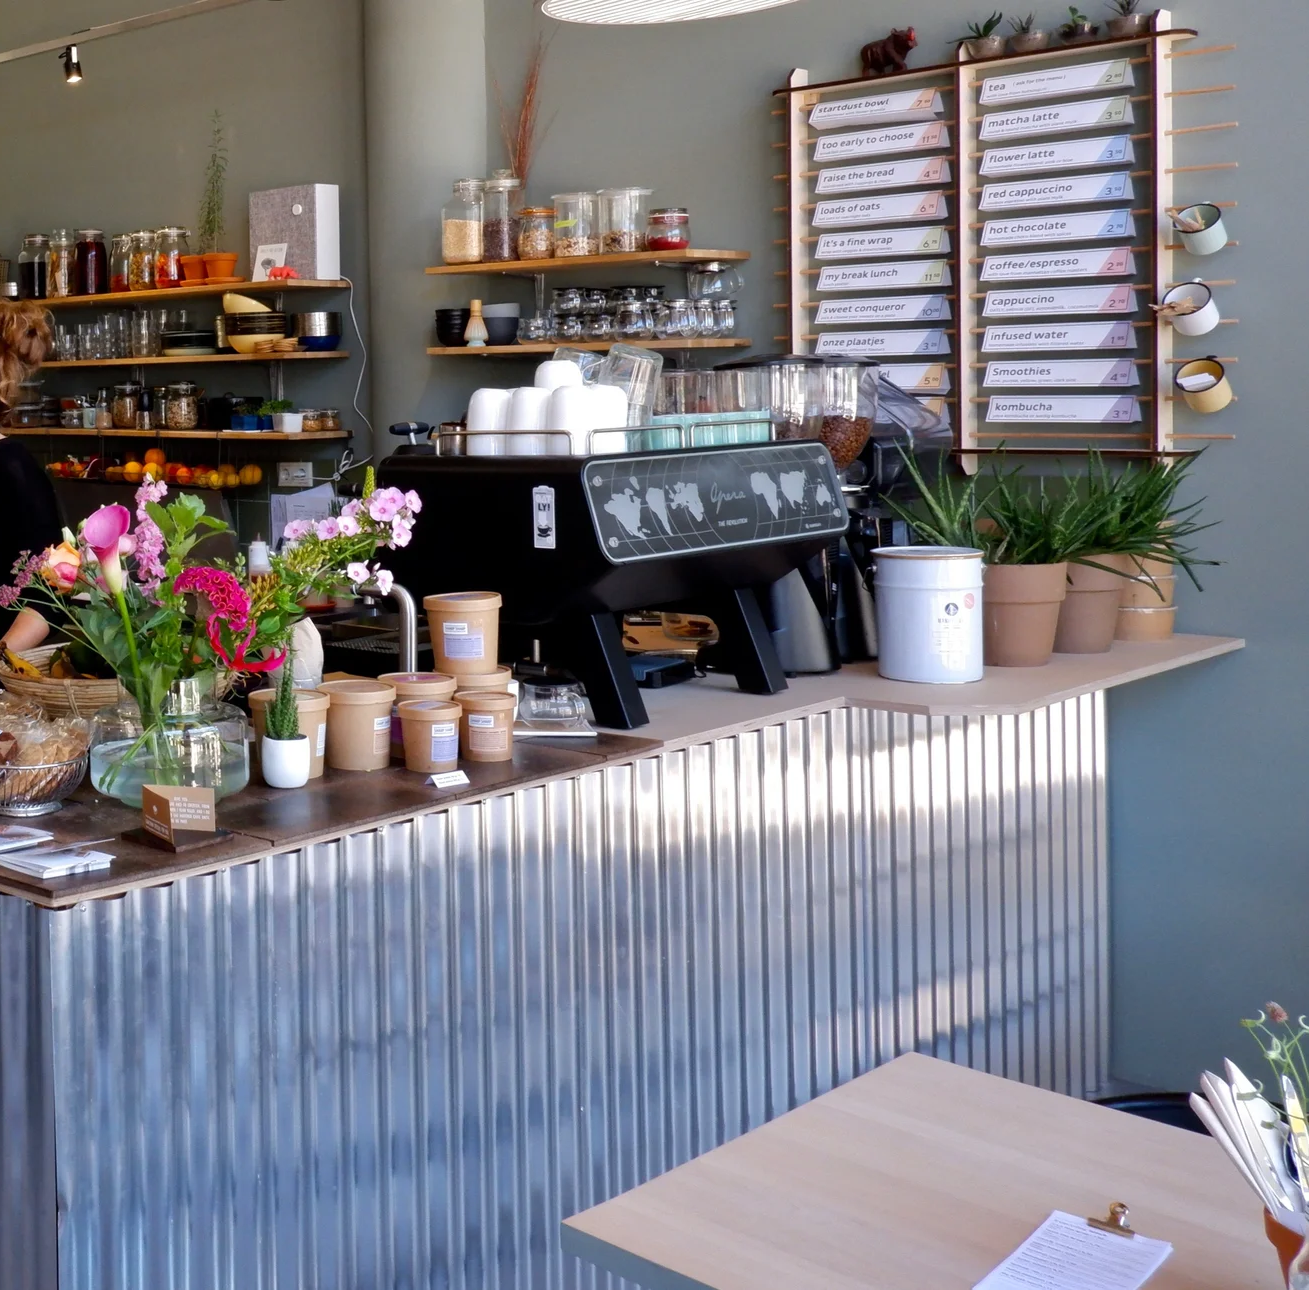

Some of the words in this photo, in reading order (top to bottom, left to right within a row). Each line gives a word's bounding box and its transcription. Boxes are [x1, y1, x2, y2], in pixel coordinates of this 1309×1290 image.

[988, 83, 1006, 91] tea
[818, 102, 862, 113] startdust
[865, 98, 890, 108] bowl
[988, 116, 1029, 128] matcha
[1032, 111, 1060, 122] latte
[822, 139, 838, 149] too
[840, 137, 864, 148] early
[866, 135, 876, 144] to
[879, 132, 914, 142] choose
[989, 152, 1026, 163] flower
[1028, 149, 1055, 159] latte
[823, 172, 846, 182] raise
[848, 171, 864, 180] the
[866, 168, 894, 178] bread
[988, 189, 1006, 198] red
[1009, 184, 1072, 197] cappuccino
[820, 205, 845, 215] loads
[848, 204, 858, 213] of
[859, 203, 880, 211] oats
[989, 225, 1008, 235] hot
[1011, 222, 1067, 233] chocolate
[823, 239, 838, 248] it's
[847, 237, 865, 246] fine
[867, 236, 893, 245] wrap
[989, 257, 1079, 270] coffee/espresso
[824, 273, 840, 282] my
[841, 270, 868, 280] break
[870, 268, 898, 278] lunch
[992, 294, 1055, 307] cappuccino
[823, 304, 852, 313] sweet
[854, 303, 906, 314] conqueror
[990, 331, 1032, 340] infused
[1034, 330, 1068, 339] water
[823, 339, 845, 347] onze
[846, 337, 885, 348] plaatjes
[992, 367, 1051, 376] Smoothies
[994, 402, 1053, 411] kombucha
[710, 481, 746, 515] Opera
